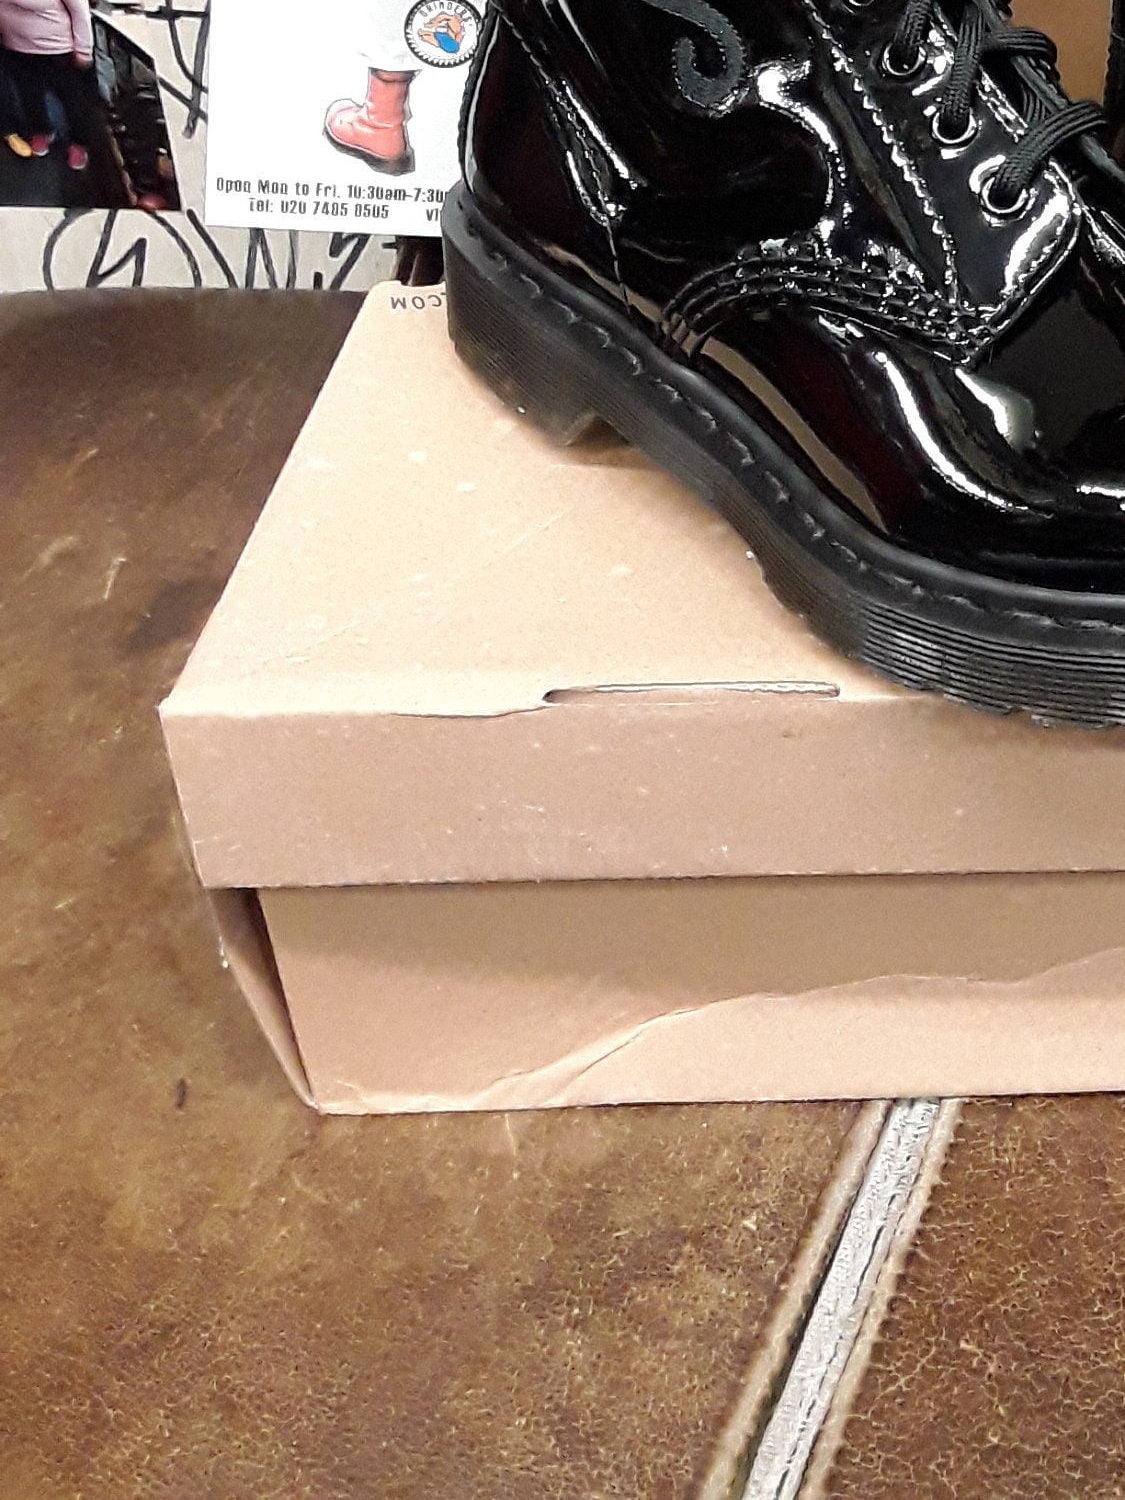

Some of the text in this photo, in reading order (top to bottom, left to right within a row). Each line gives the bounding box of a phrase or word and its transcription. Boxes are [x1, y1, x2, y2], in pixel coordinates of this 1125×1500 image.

[257, 179, 288, 195] Mon
[295, 182, 310, 197] to
[280, 199, 307, 215] 020
